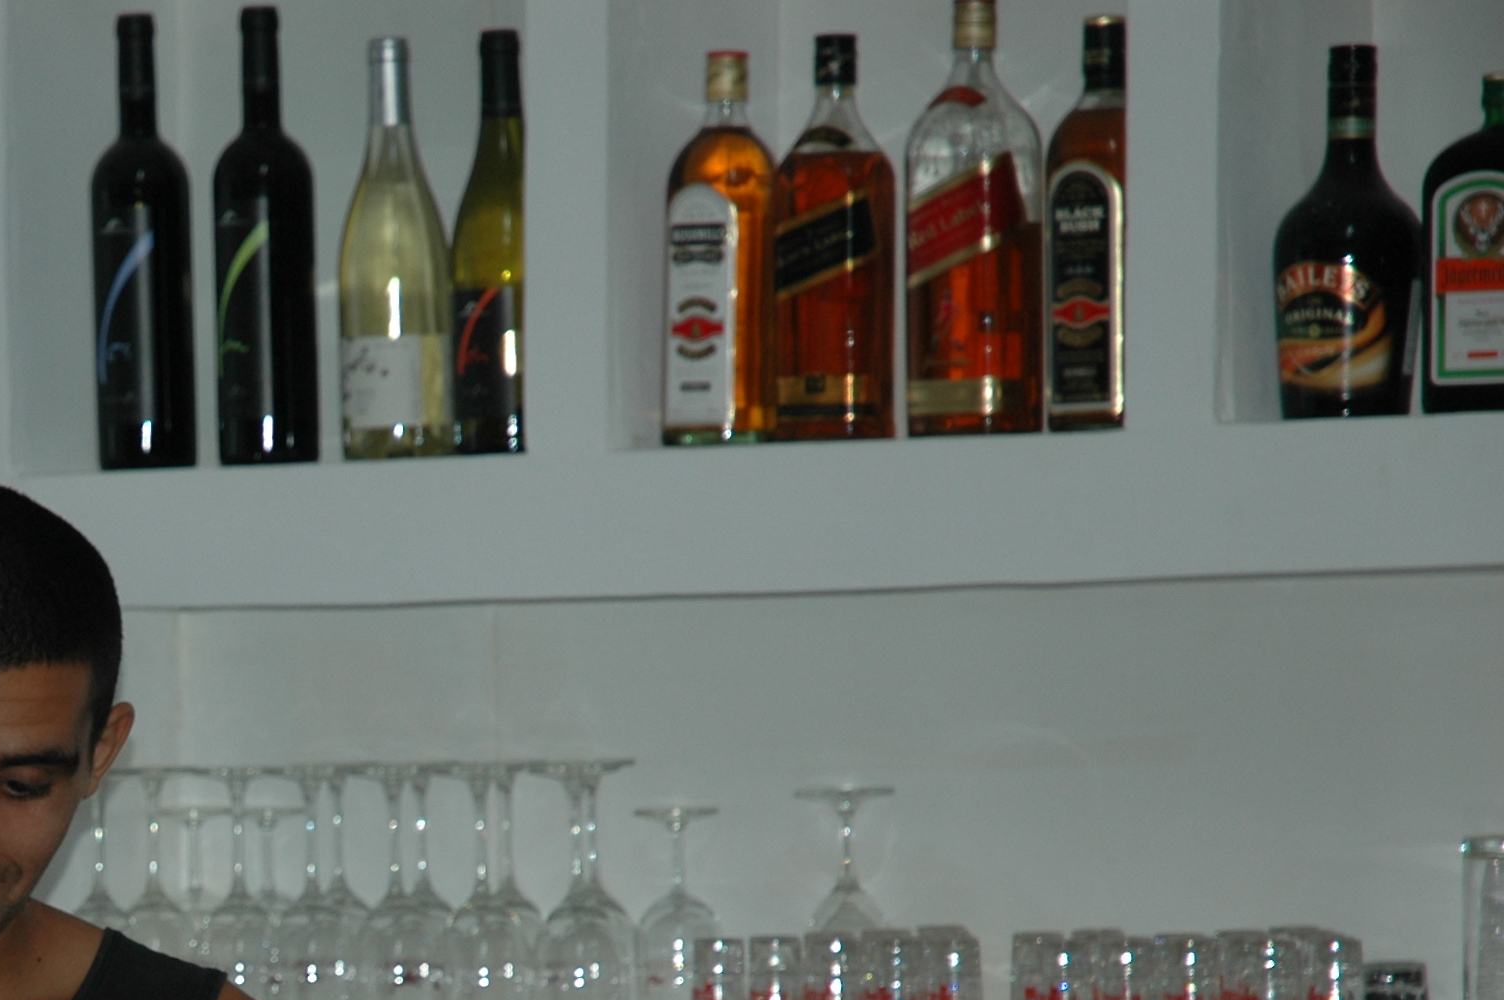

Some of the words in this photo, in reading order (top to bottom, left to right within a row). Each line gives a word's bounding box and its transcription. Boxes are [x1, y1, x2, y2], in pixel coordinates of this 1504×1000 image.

[1055, 206, 1106, 220] BLACK
[1277, 262, 1370, 302] BAILES
[1284, 306, 1354, 326] ORIGINAL
